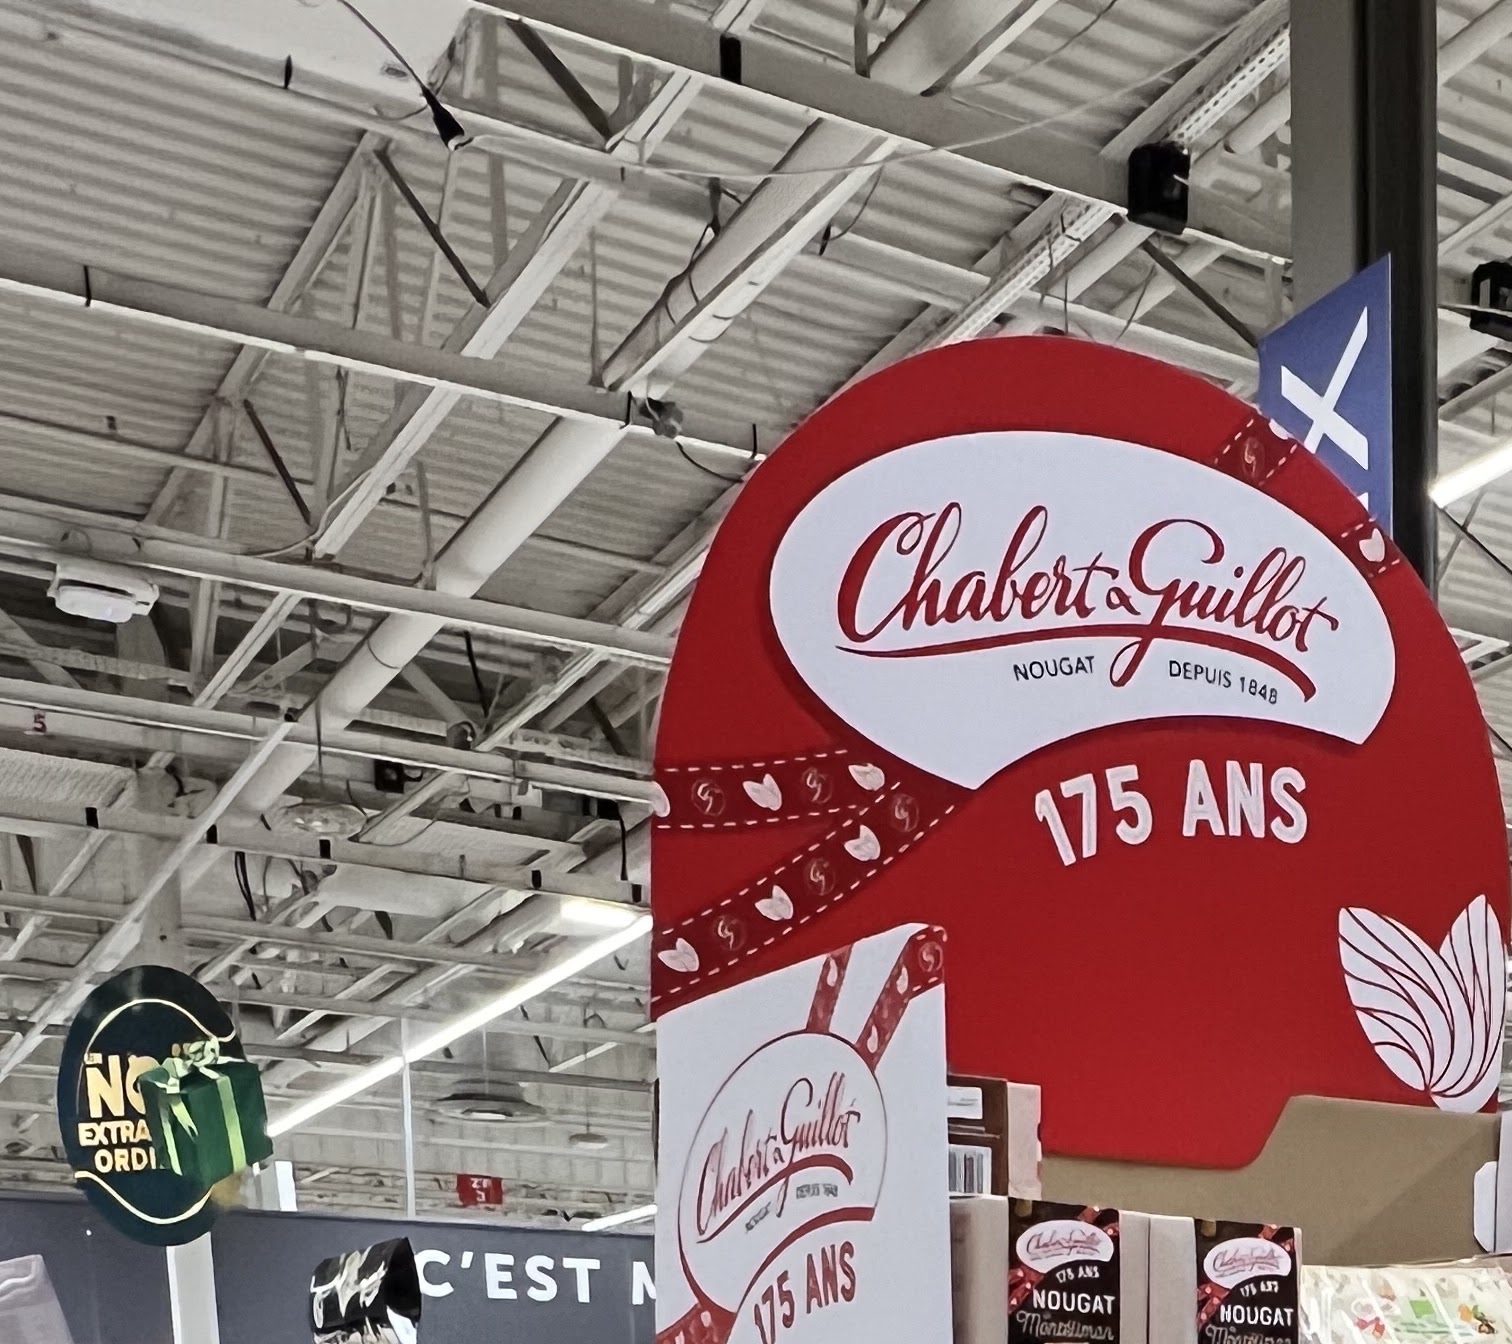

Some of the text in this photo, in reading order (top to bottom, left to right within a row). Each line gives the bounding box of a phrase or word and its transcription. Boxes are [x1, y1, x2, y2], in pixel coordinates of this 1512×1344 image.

[837, 501, 1119, 643] Chabert
[1110, 518, 1339, 688] Guillot
[1013, 655, 1279, 706] NOUGAT DEPUIS 1848
[1034, 759, 1308, 867] 175 ANS
[78, 1119, 152, 1147] EXTRA
[414, 1249, 601, 1303] C'EST
[806, 1240, 856, 1314] ANS
[1033, 1288, 1116, 1316] NOUGAT
[1220, 1304, 1294, 1327] NOUGAT
